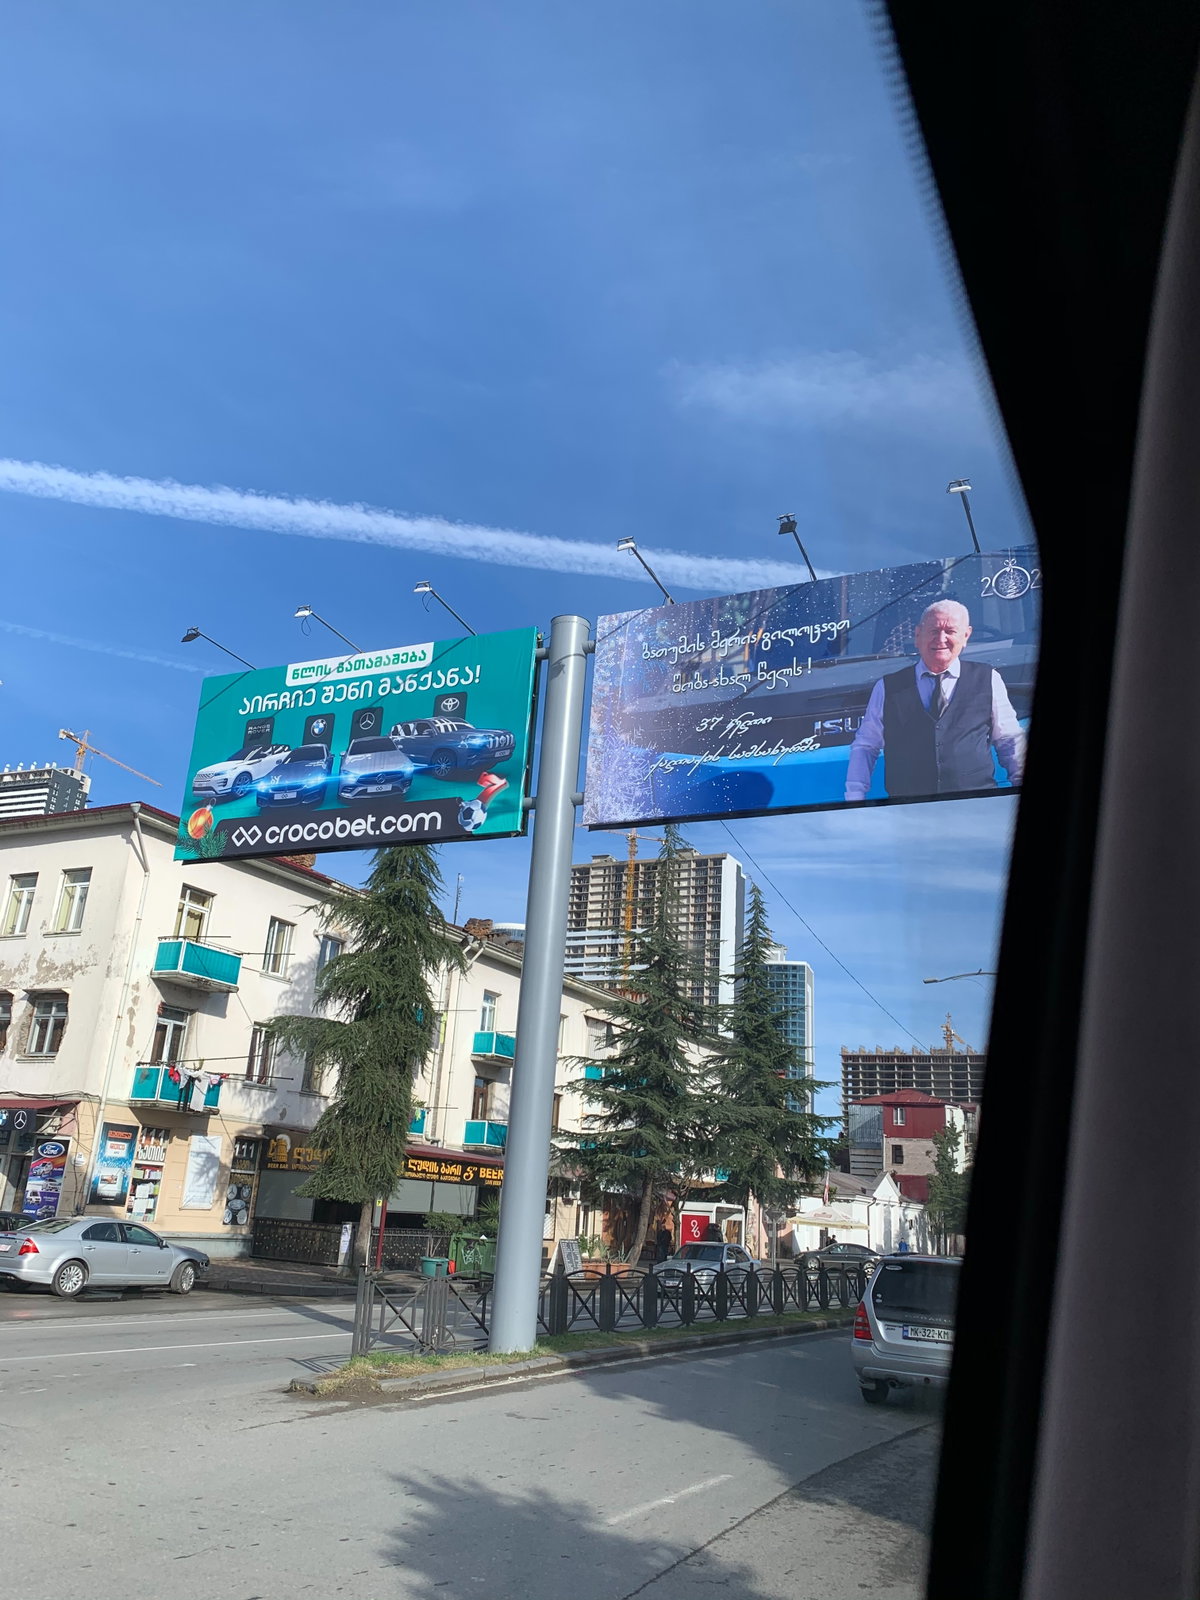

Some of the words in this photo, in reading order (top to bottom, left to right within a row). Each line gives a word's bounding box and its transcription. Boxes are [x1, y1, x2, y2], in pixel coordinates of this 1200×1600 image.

[642, 634, 706, 665] ბათუმის
[711, 628, 757, 657] მერია
[761, 619, 850, 650] გილოცავთ
[291, 664, 332, 681] წლის
[336, 650, 428, 674] გათამაშება
[238, 688, 317, 715] აირჩიე
[321, 679, 373, 704] შენი
[377, 664, 481, 697] მანქანა!
[696, 716, 723, 732] 37
[265, 811, 442, 844] crocobet.com
[234, 1141, 255, 1159] 111
[408, 1158, 439, 1174] ლუდის
[440, 1162, 462, 1176] ბარი
[479, 1167, 504, 1180] BEER
